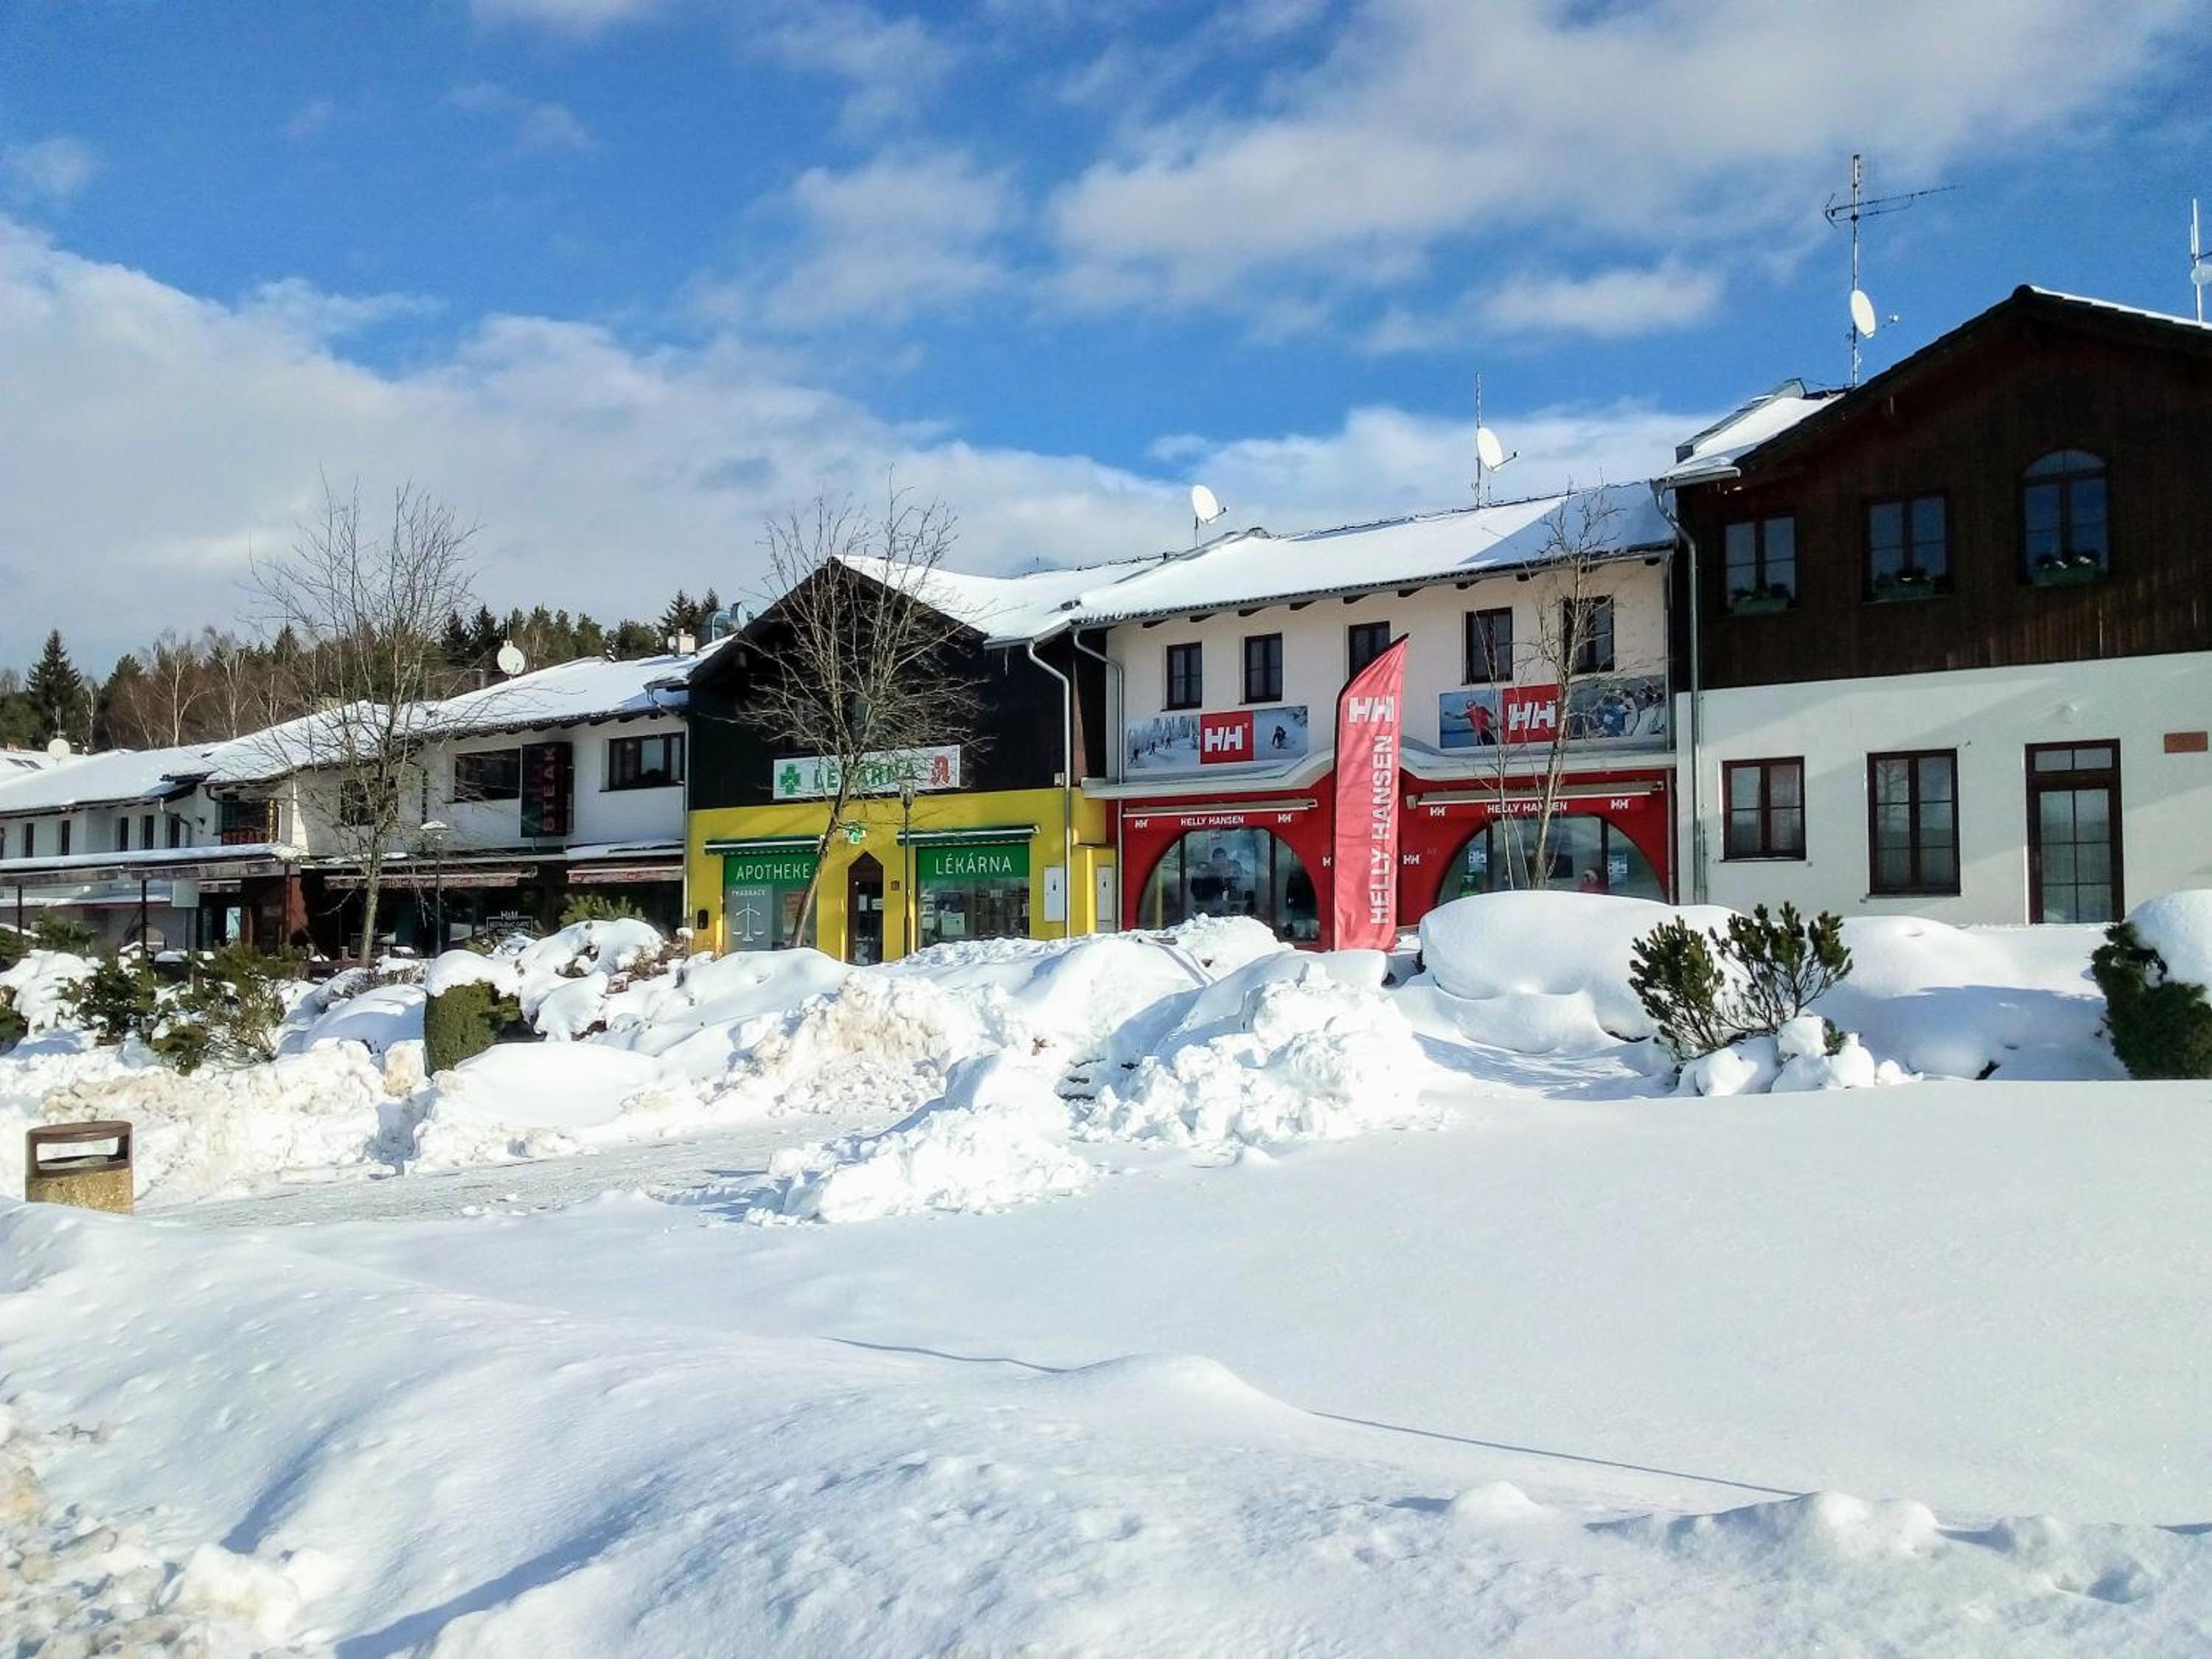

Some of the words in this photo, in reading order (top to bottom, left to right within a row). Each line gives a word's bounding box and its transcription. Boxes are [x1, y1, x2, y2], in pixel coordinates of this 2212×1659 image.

[543, 746, 555, 832] STEAK
[1371, 735, 1393, 840] HANSEN
[1487, 803, 1520, 814] HELLY
[1180, 815, 1207, 827] HELLY
[1208, 815, 1245, 826] HANSEN
[736, 863, 810, 880] APOTHEKE
[936, 852, 1012, 874] LÉKÁRNA
[1369, 848, 1391, 924] HELLY
